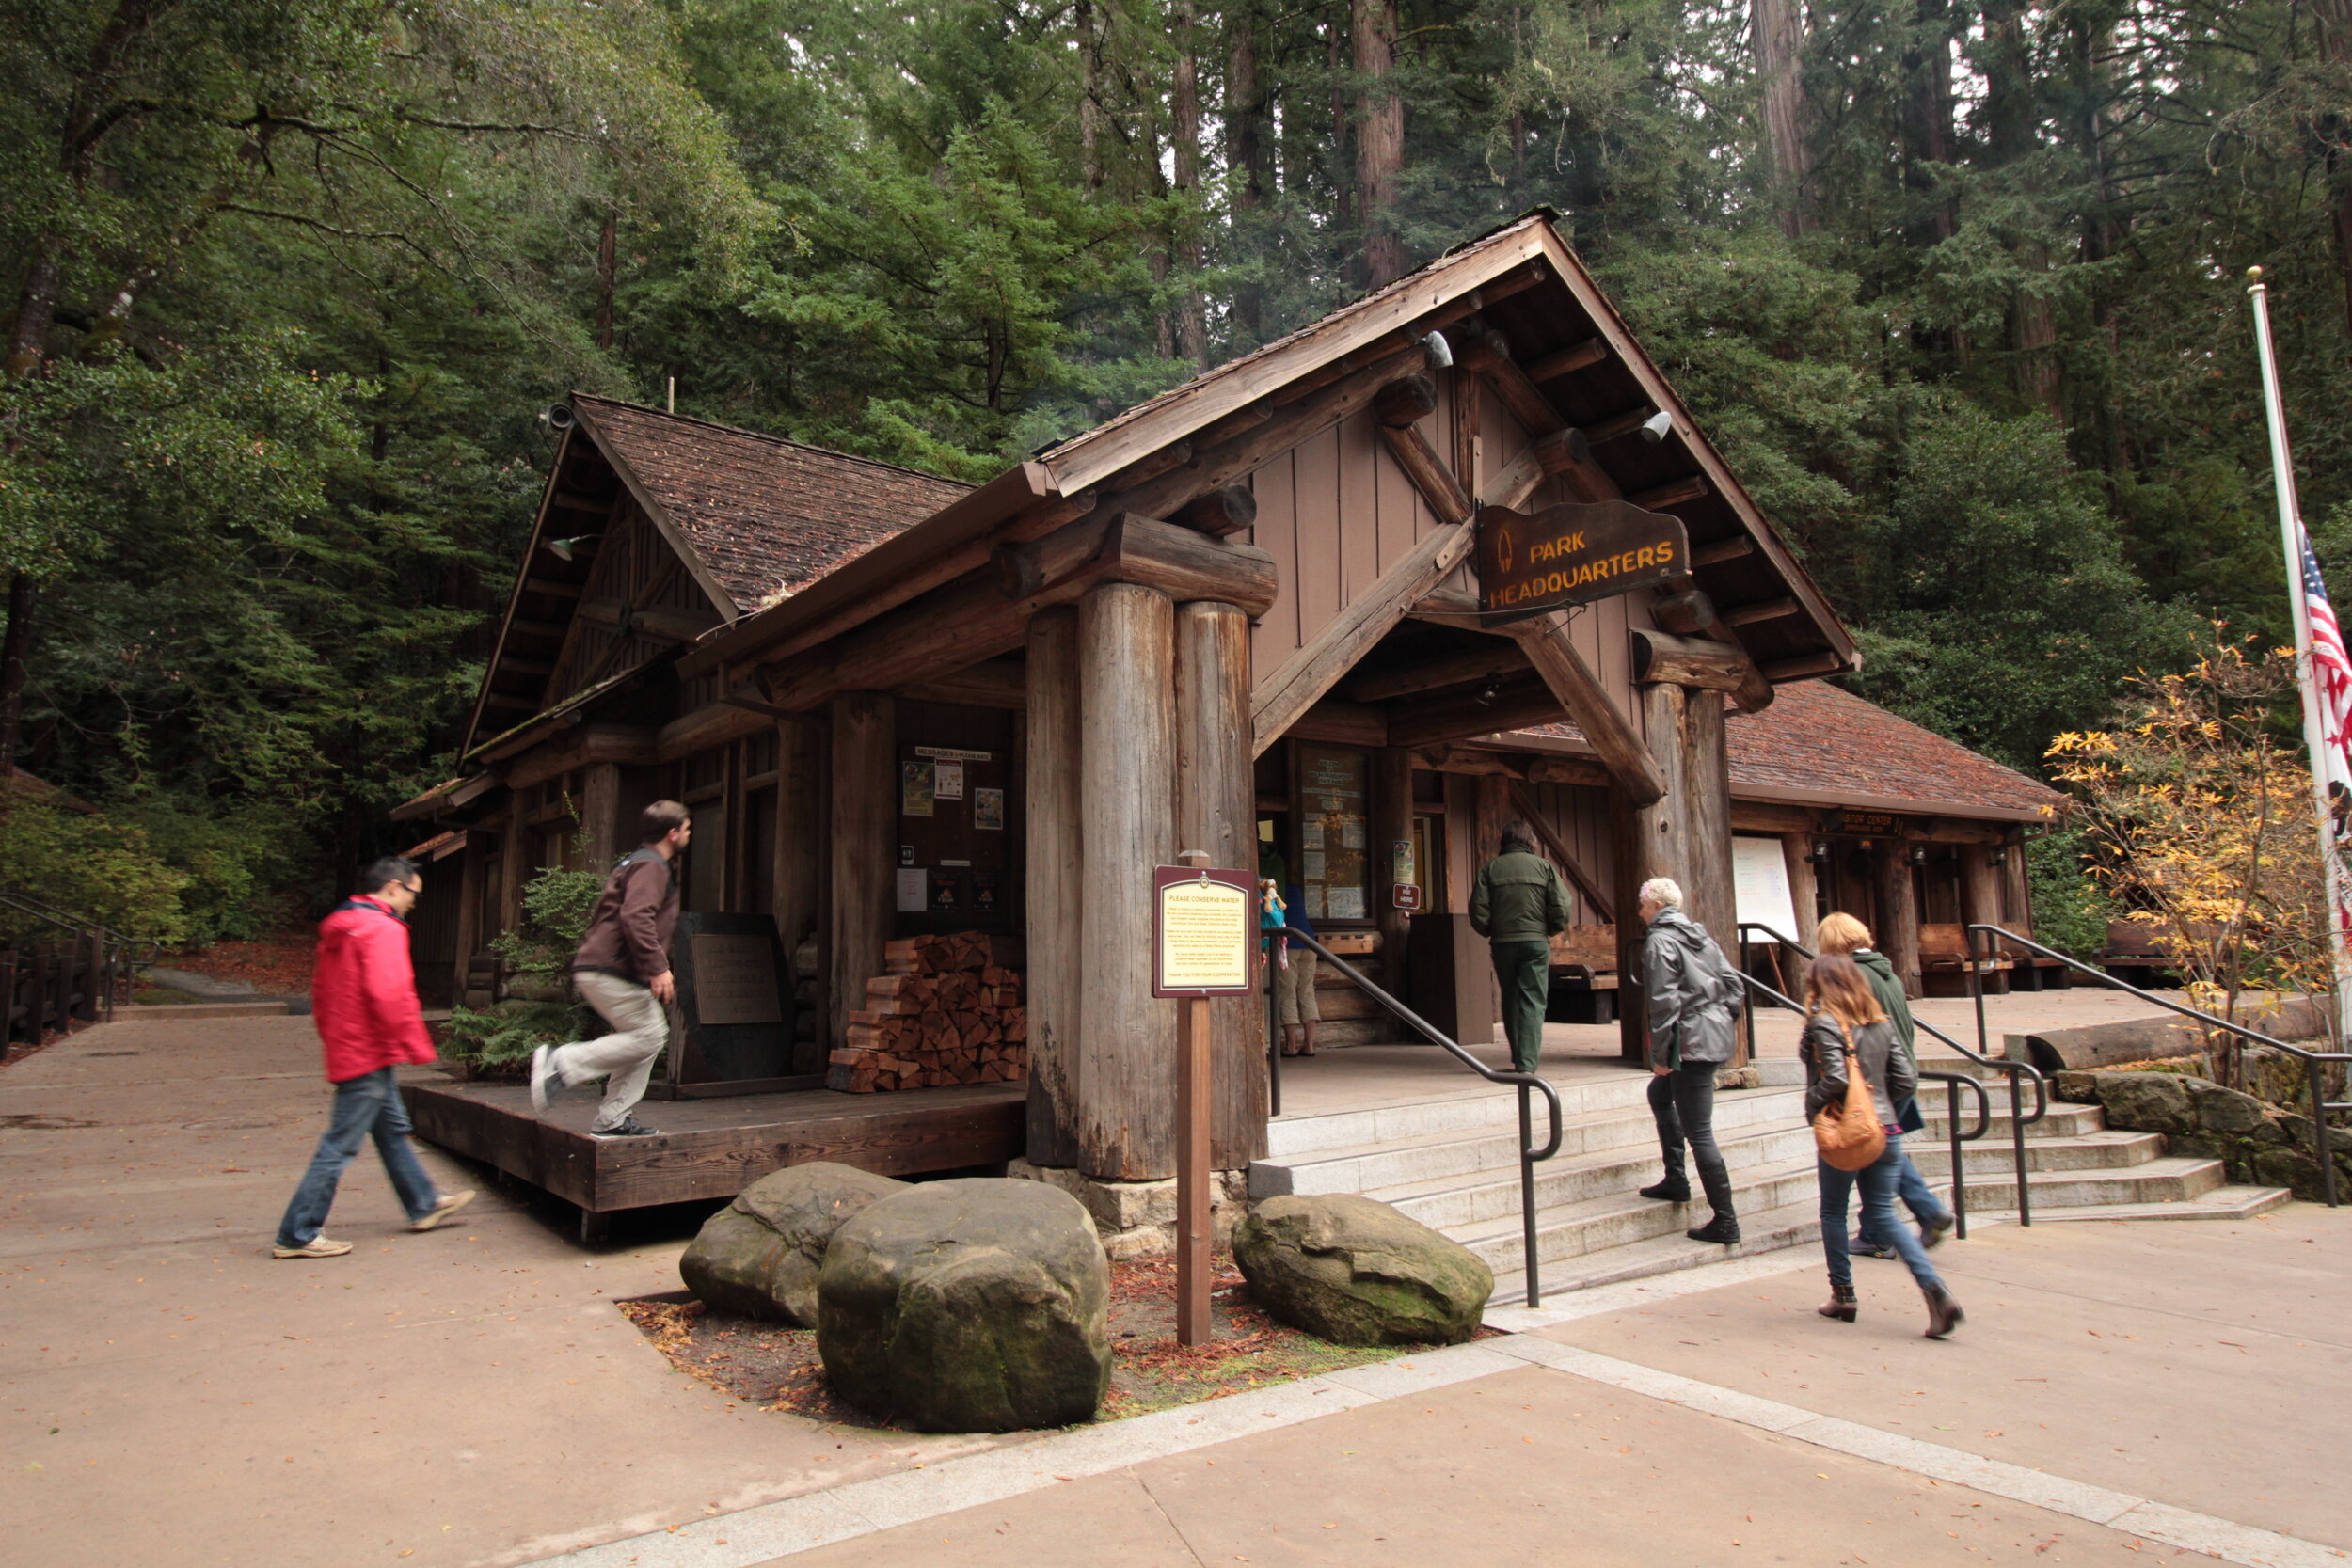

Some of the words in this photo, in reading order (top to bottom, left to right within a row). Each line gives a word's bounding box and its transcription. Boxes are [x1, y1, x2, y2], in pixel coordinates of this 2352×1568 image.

[1530, 531, 1586, 564] PARK
[1490, 540, 1674, 609] HEADQUARTERS
[917, 748, 953, 756] MESSAGES
[1844, 814, 1864, 822] SITOR
[1867, 815, 1892, 826] CENTER
